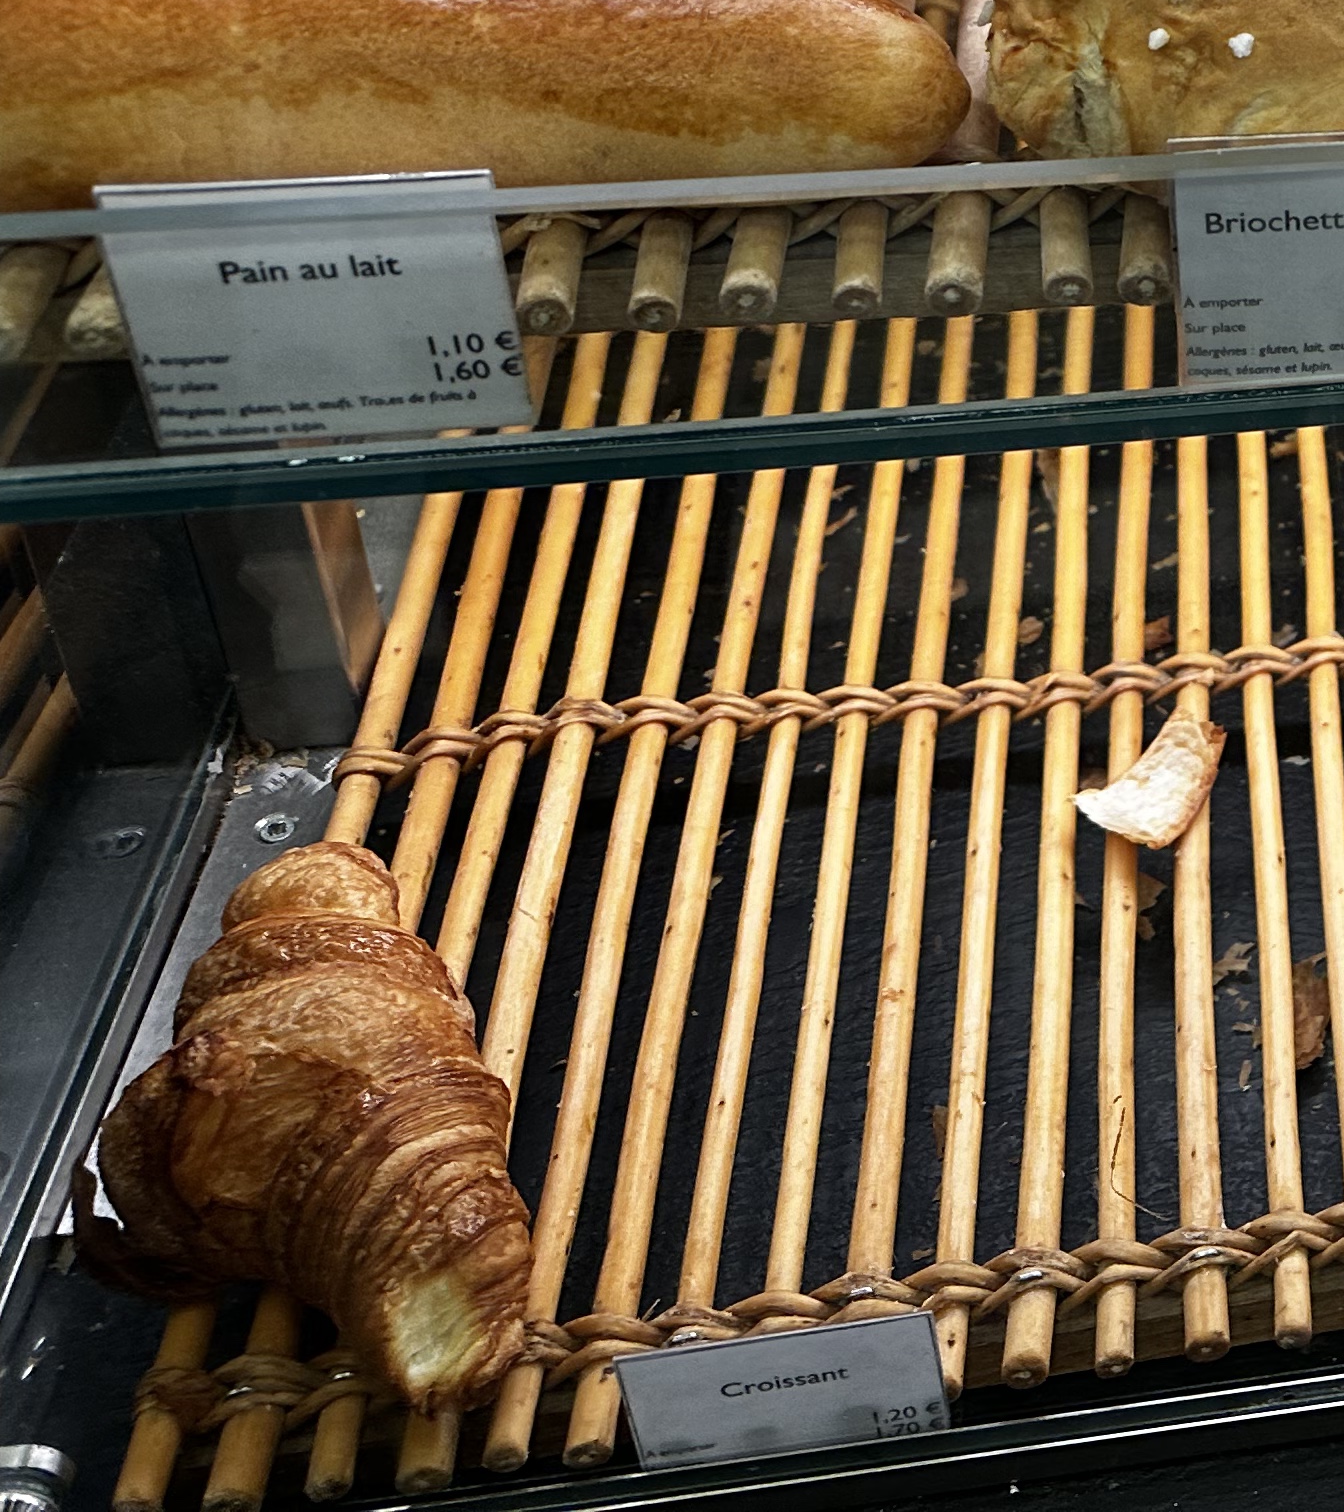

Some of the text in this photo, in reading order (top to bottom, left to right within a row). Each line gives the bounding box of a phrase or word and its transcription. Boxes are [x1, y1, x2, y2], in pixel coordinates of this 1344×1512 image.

[218, 254, 403, 285] Pain au lait
[1199, 297, 1264, 310] emporter
[1184, 322, 1246, 335] Sur place
[494, 331, 519, 351] €
[501, 354, 523, 377] €
[1285, 363, 1298, 373] et
[720, 1367, 849, 1398] Croissant
[926, 1401, 943, 1415] €
